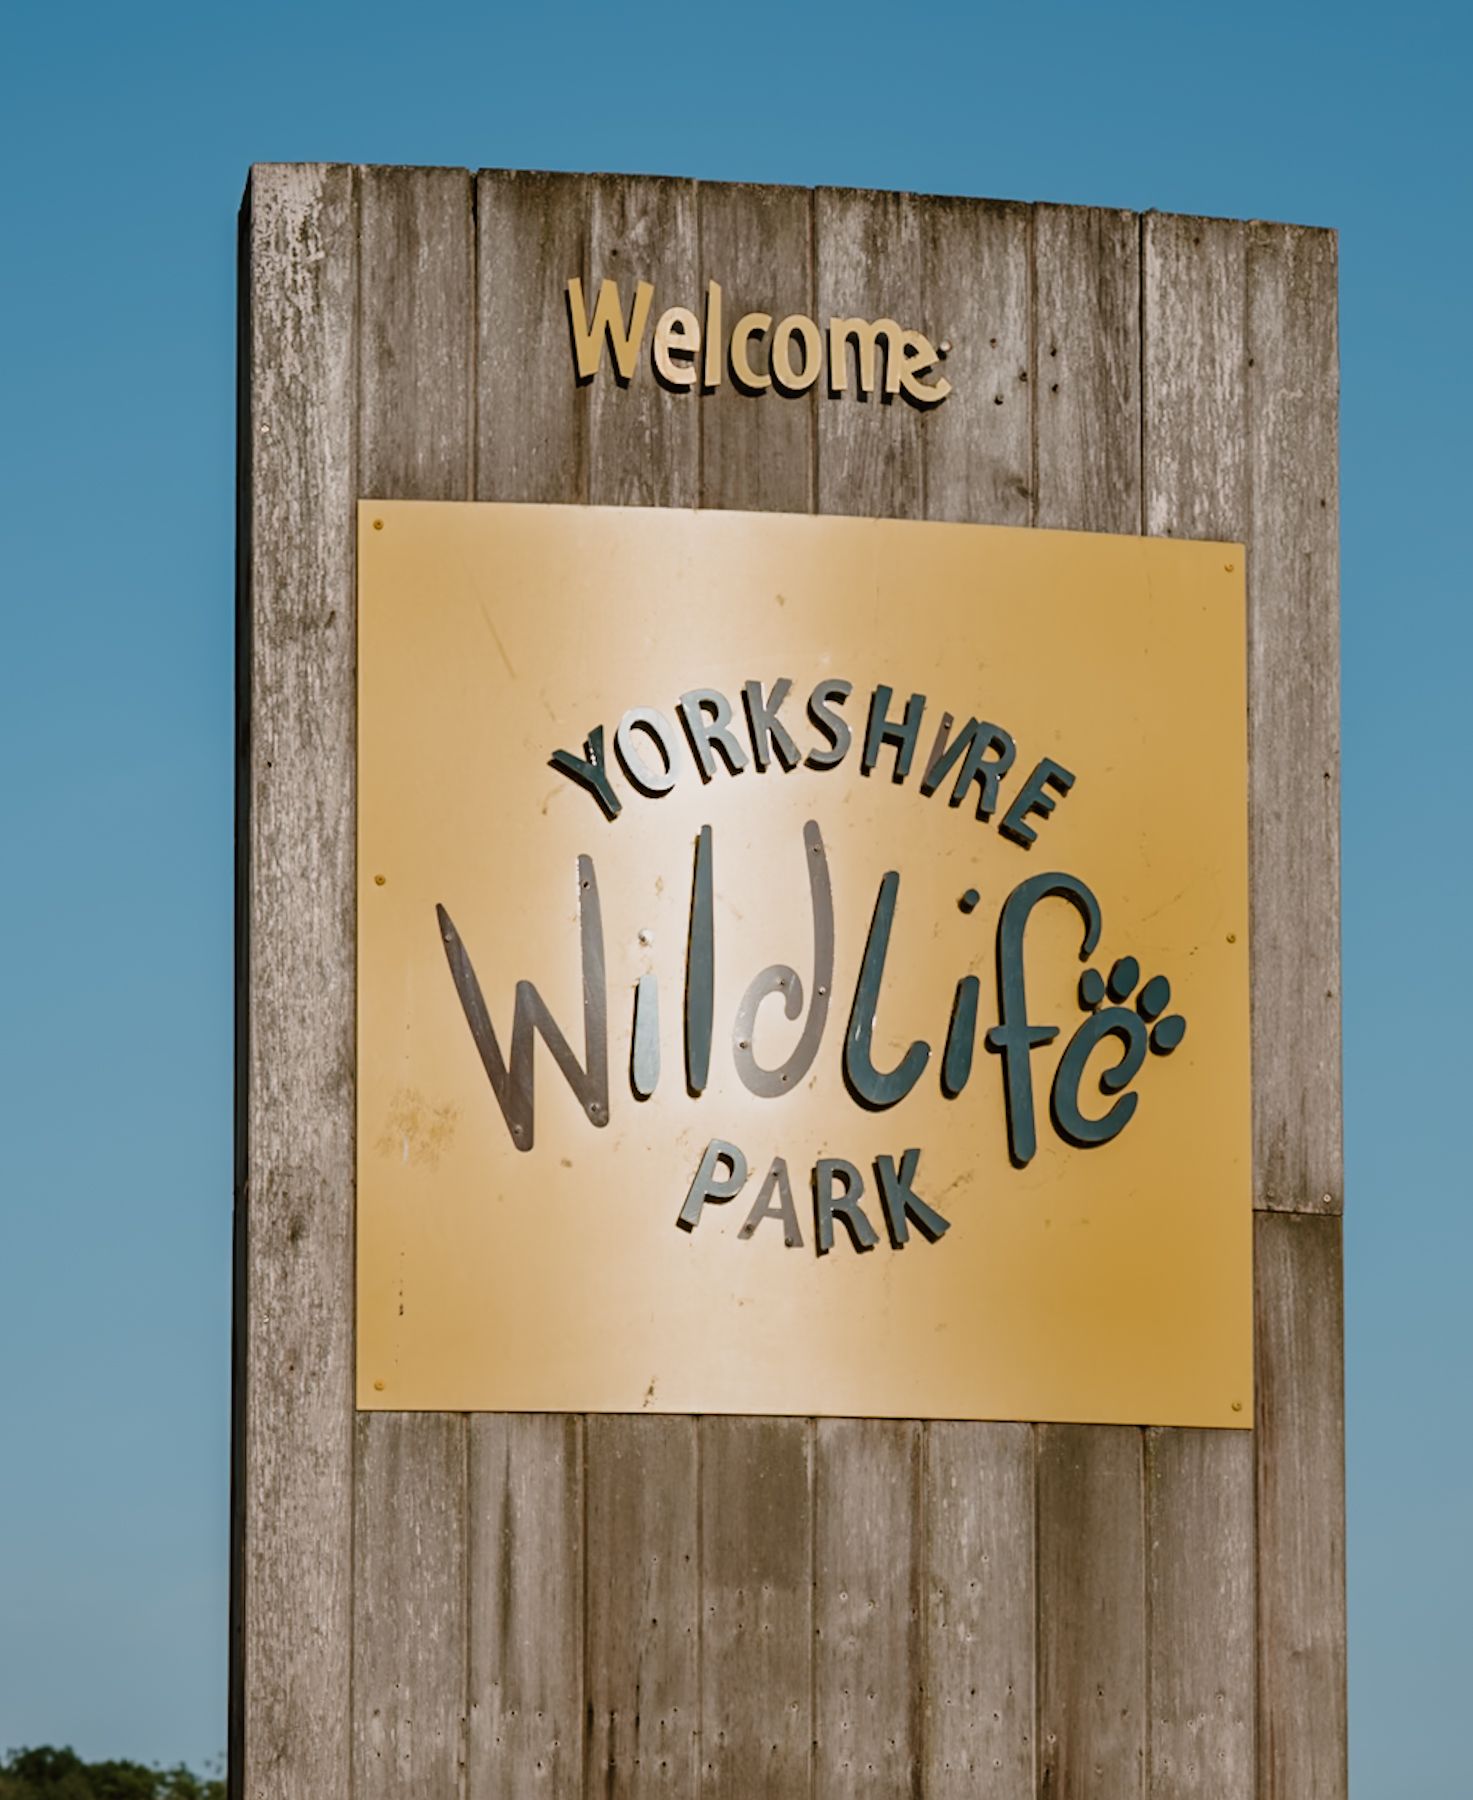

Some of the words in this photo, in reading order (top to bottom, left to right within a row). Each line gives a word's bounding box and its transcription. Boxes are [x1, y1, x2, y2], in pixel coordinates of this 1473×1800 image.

[566, 277, 953, 403] Welcome
[549, 678, 1076, 849] YORKSHIRE
[677, 1139, 950, 1257] PARK
